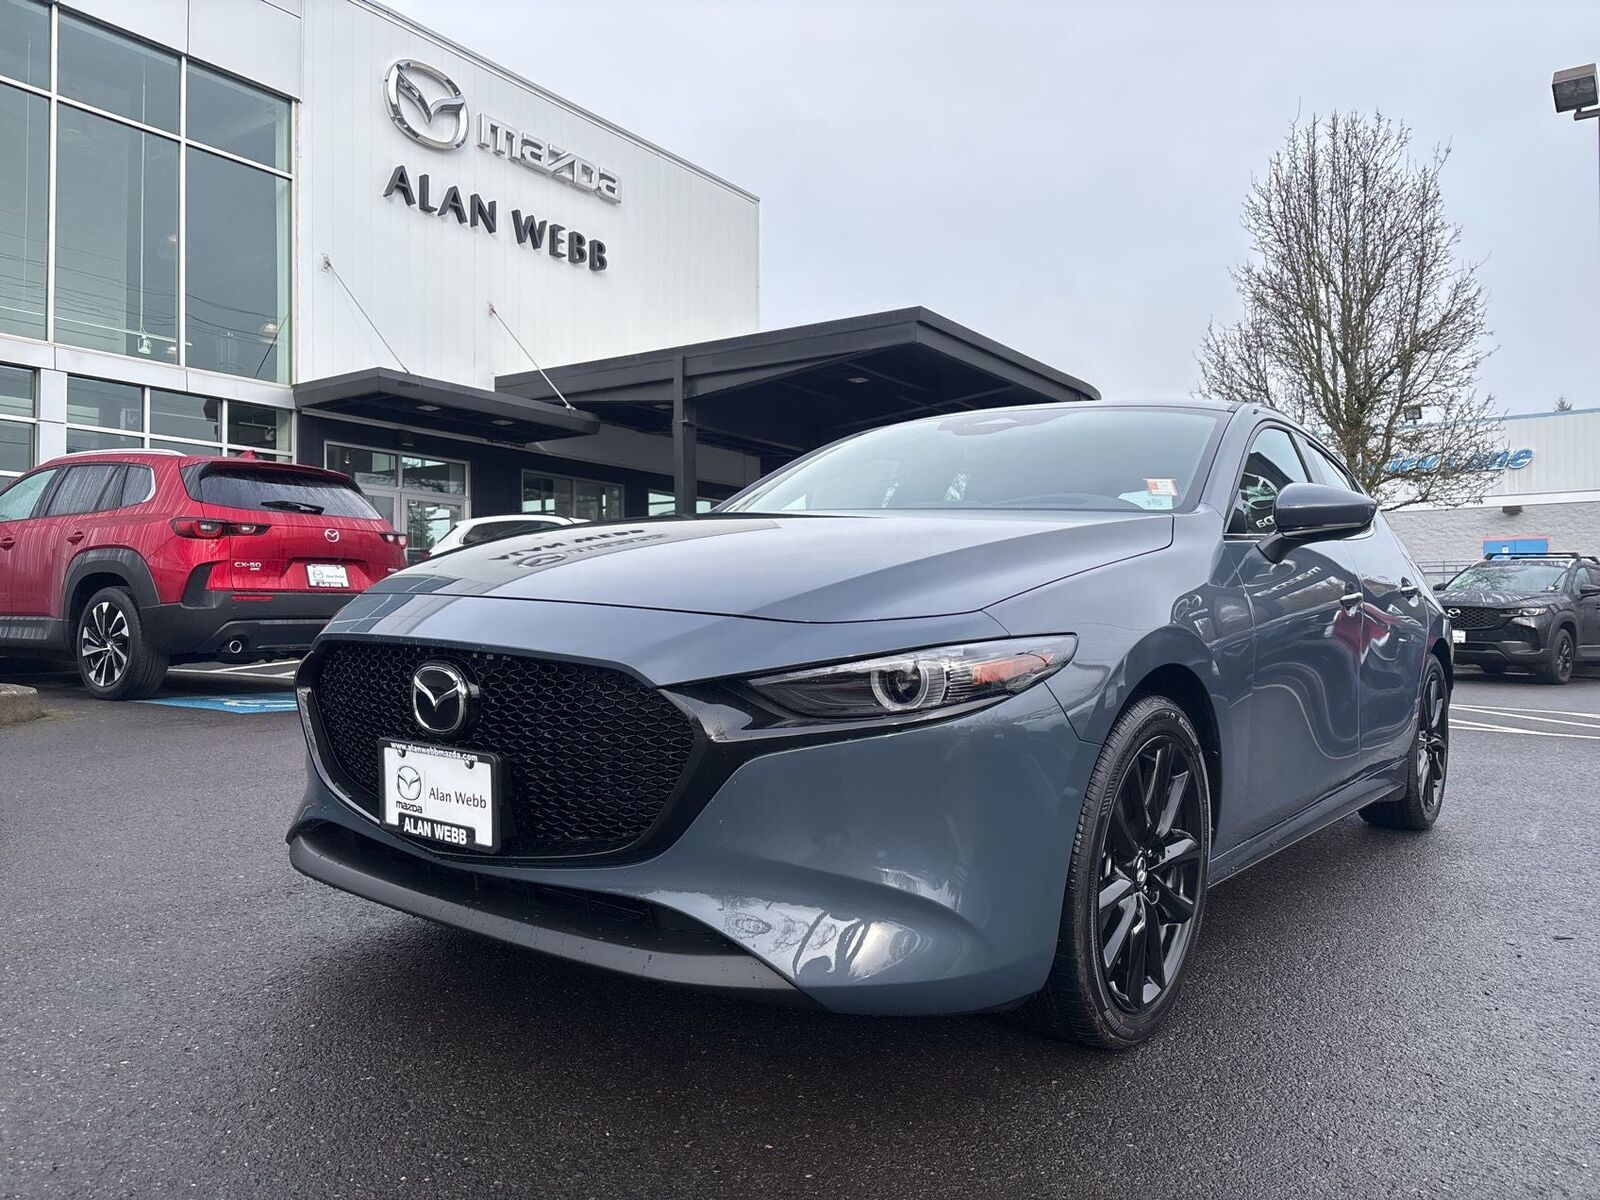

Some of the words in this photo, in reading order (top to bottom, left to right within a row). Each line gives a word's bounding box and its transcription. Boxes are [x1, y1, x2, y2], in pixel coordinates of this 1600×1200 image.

[383, 164, 497, 234] ALAN
[511, 208, 608, 272] WEBB
[234, 561, 262, 569] CX-50
[390, 742, 479, 763] www.alanwebbmazda.com
[428, 787, 452, 803] Alan
[455, 791, 487, 809] Webb
[403, 817, 432, 838] ALAN
[434, 823, 468, 846] WEBB
